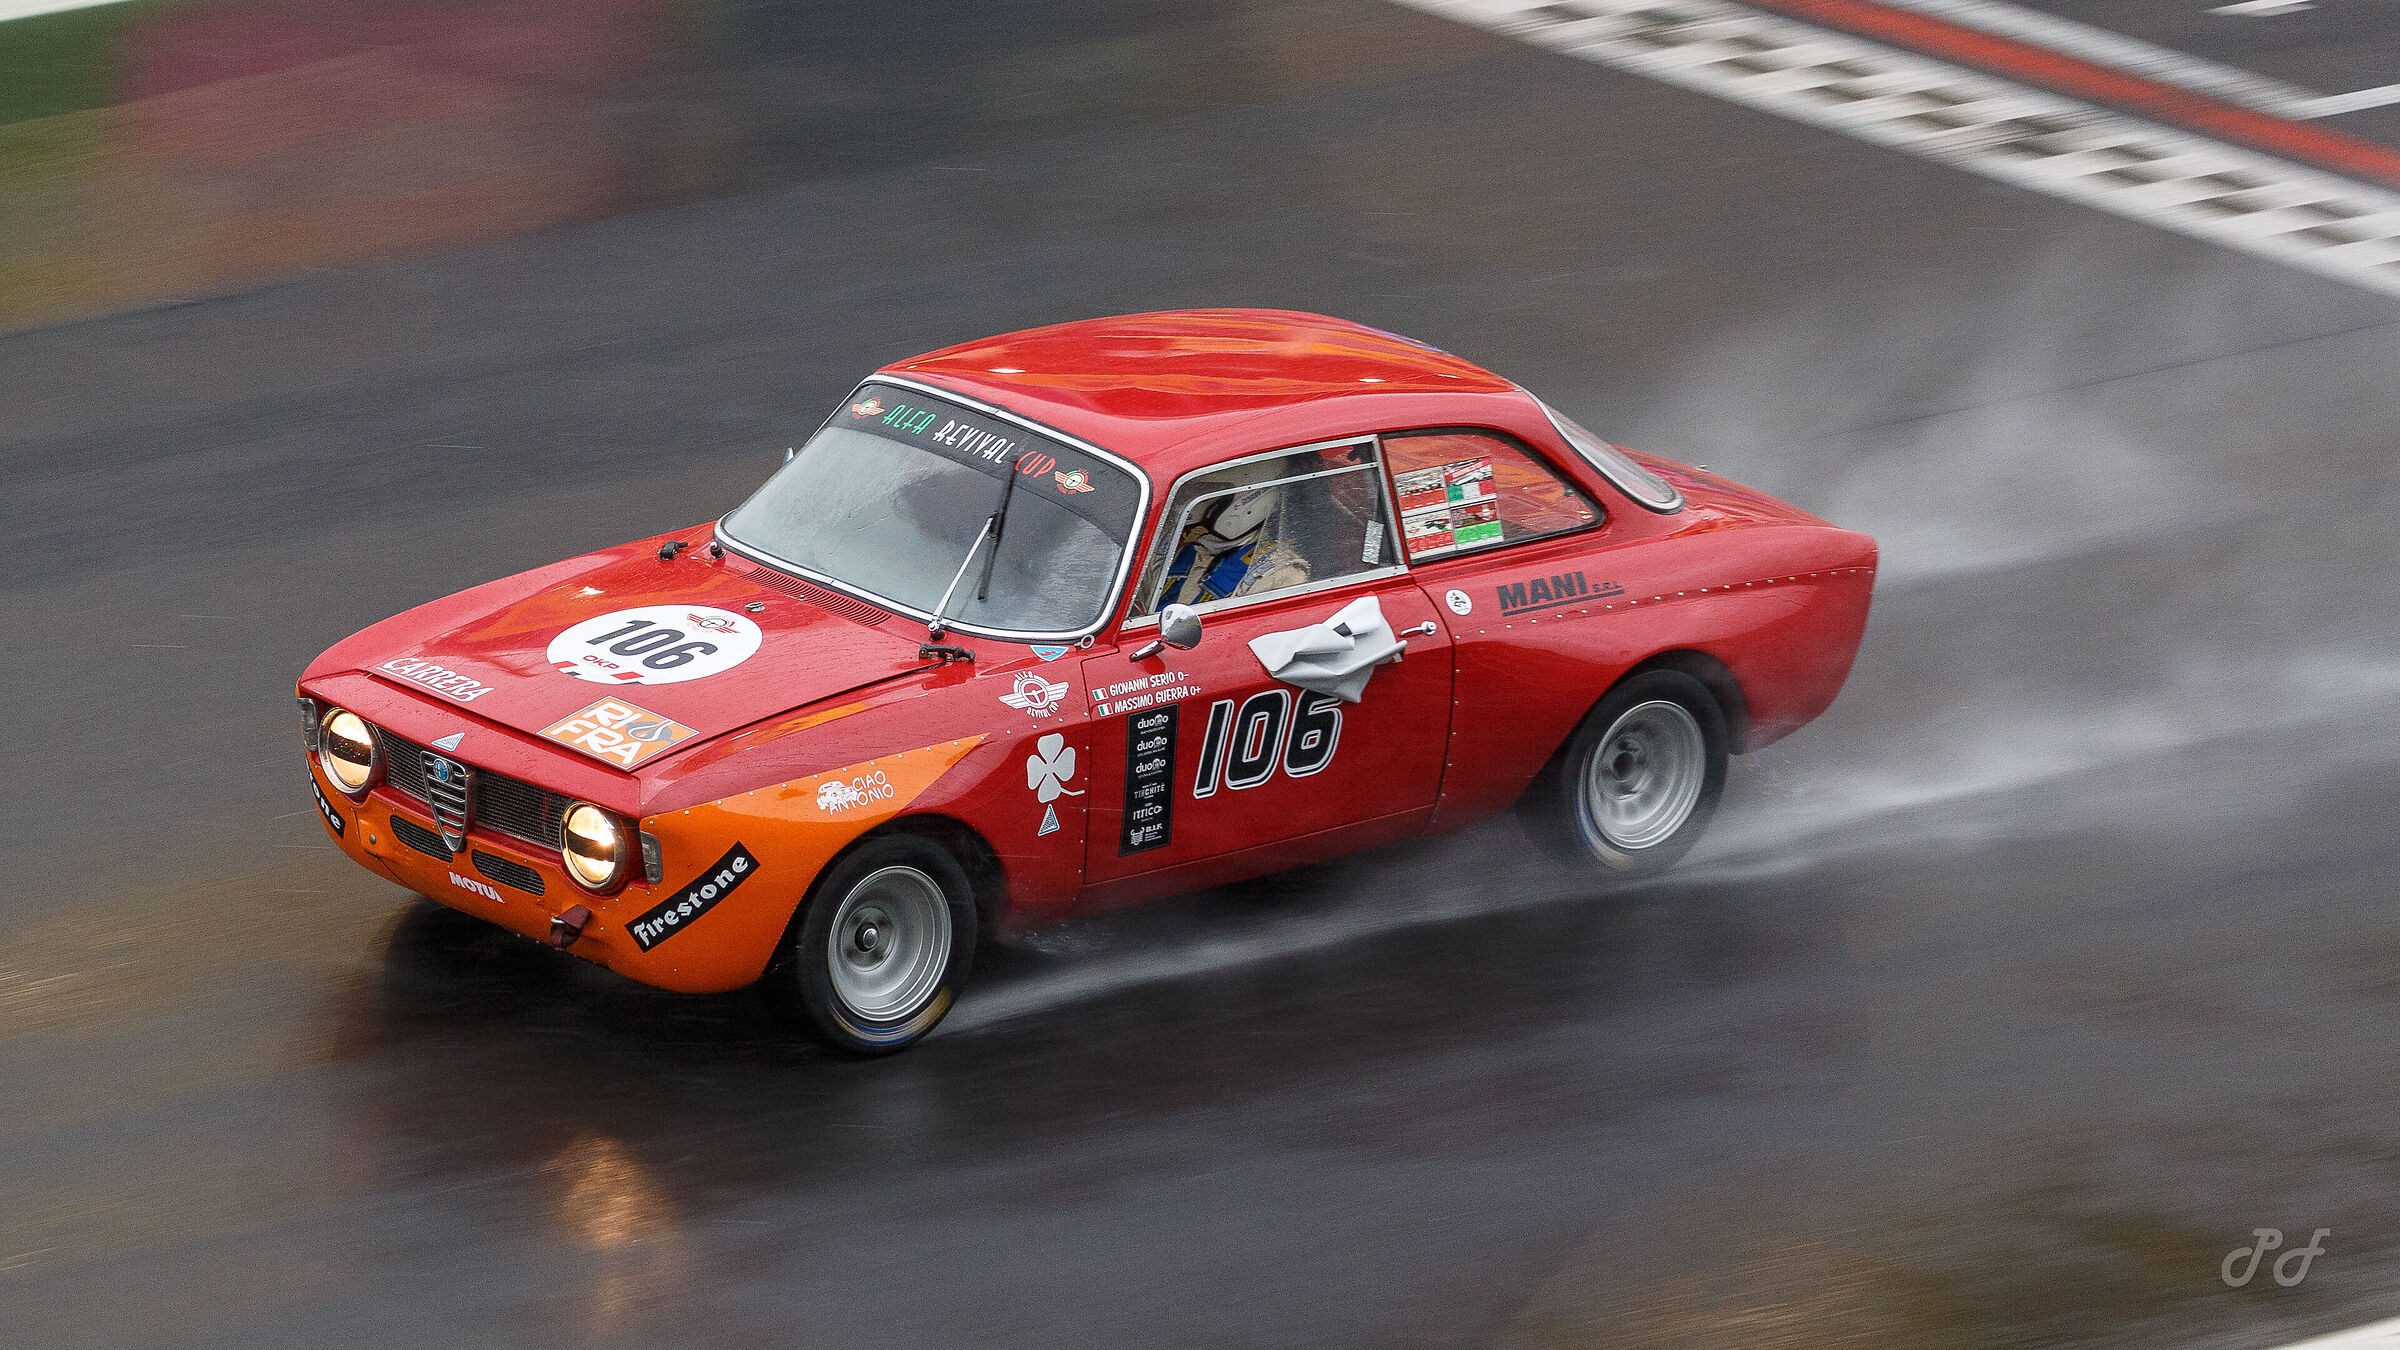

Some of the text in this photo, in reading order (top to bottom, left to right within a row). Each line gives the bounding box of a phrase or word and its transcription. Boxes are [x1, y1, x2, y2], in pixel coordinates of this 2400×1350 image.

[882, 404, 937, 435] ALFA
[932, 418, 1016, 464] REVIVAL
[1014, 450, 1056, 479] CUP
[1496, 571, 1588, 611] MANI
[582, 654, 620, 671] OKP
[586, 619, 718, 670] 106
[381, 657, 495, 703] CARRERA
[1109, 677, 1149, 697] GIOVANNI
[1150, 671, 1175, 688] SERIO
[1114, 693, 1154, 714] MASSIMO
[1155, 685, 1189, 703] GUERRA
[550, 719, 643, 765] FRA
[1192, 688, 1344, 800] 106
[829, 783, 894, 816] ANTONIO
[852, 770, 886, 792] CIAO
[633, 853, 750, 949] Firestone
